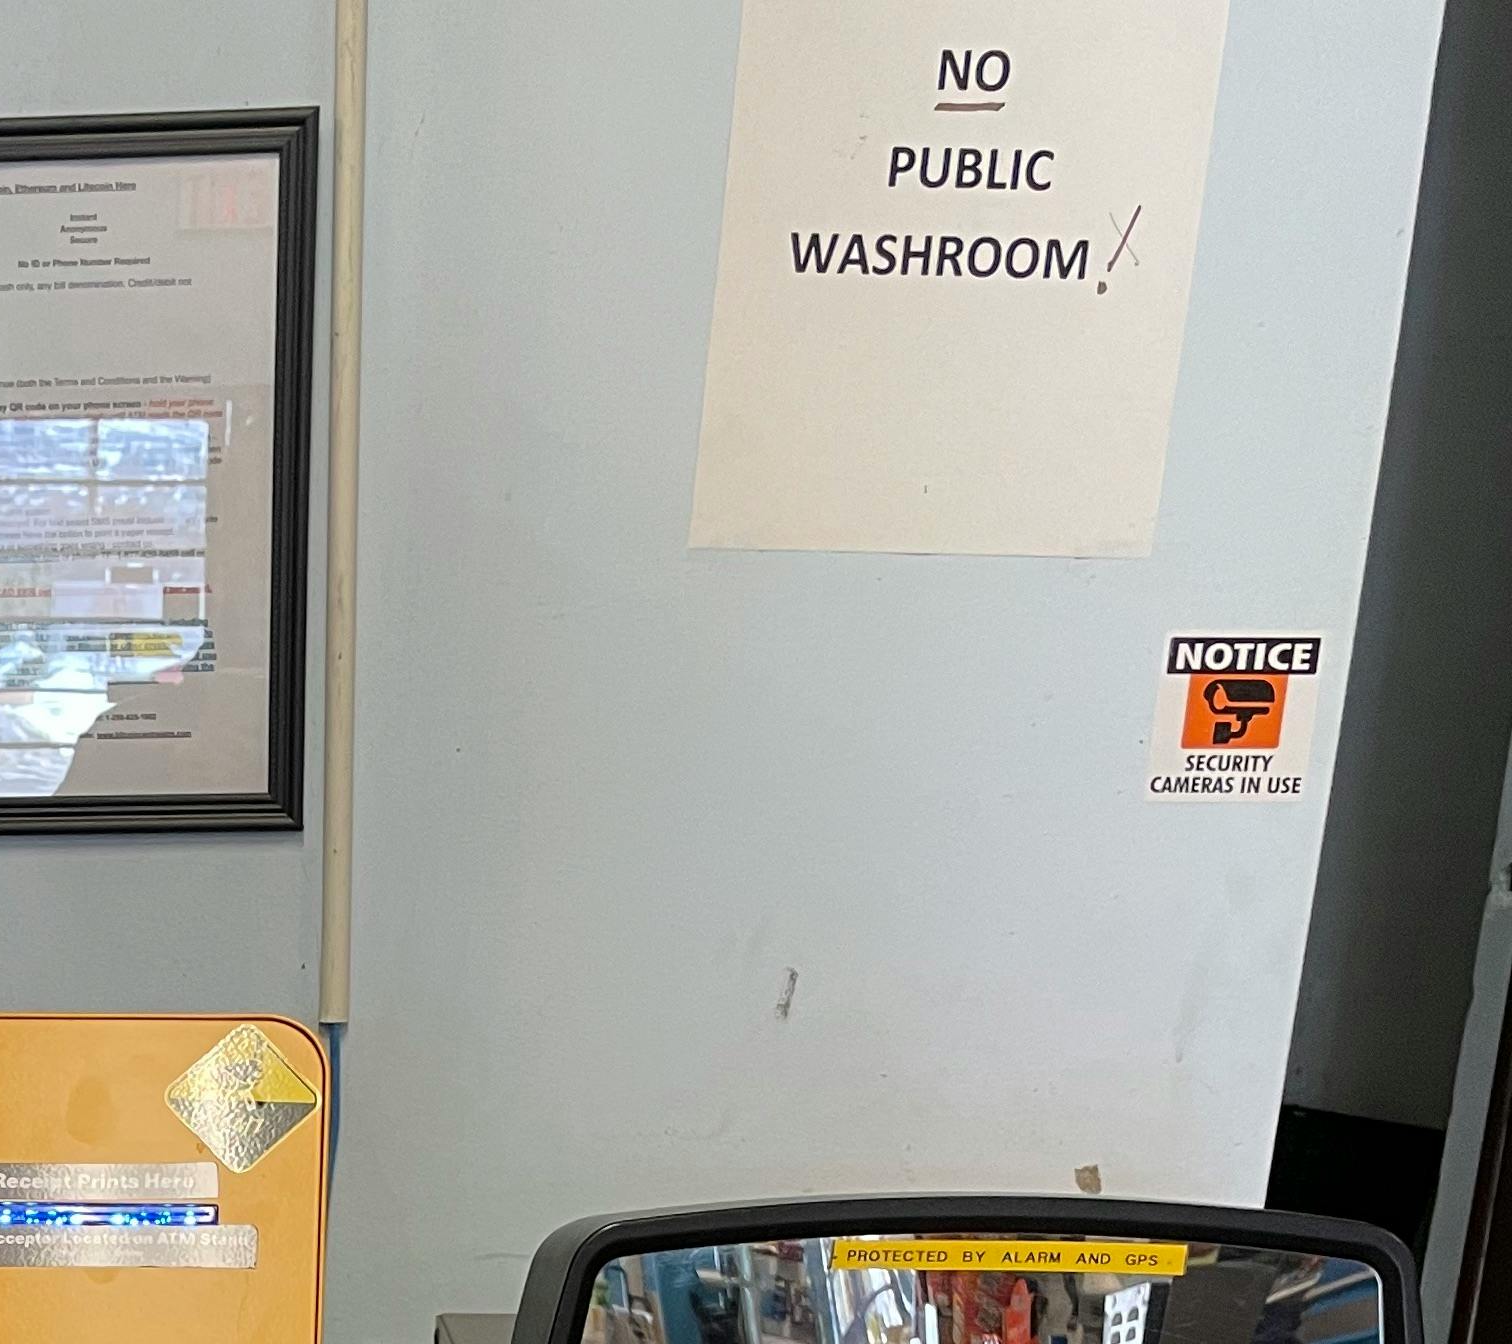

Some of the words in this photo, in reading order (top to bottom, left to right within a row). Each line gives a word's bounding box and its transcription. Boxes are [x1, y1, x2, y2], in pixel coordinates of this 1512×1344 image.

[937, 49, 1011, 92] NO
[888, 147, 1054, 191] PUBLIC
[1176, 643, 1312, 670] NOTICE
[1185, 755, 1272, 772] SECURITY
[1150, 776, 1234, 793] CAMERAS
[1240, 777, 1260, 793] IN
[1267, 777, 1302, 794] USE
[848, 1250, 948, 1263] PROTECTED
[963, 1252, 984, 1263] BY
[1002, 1252, 1061, 1264] ALARM
[1077, 1253, 1111, 1265] AND
[1125, 1254, 1158, 1266] GPS
